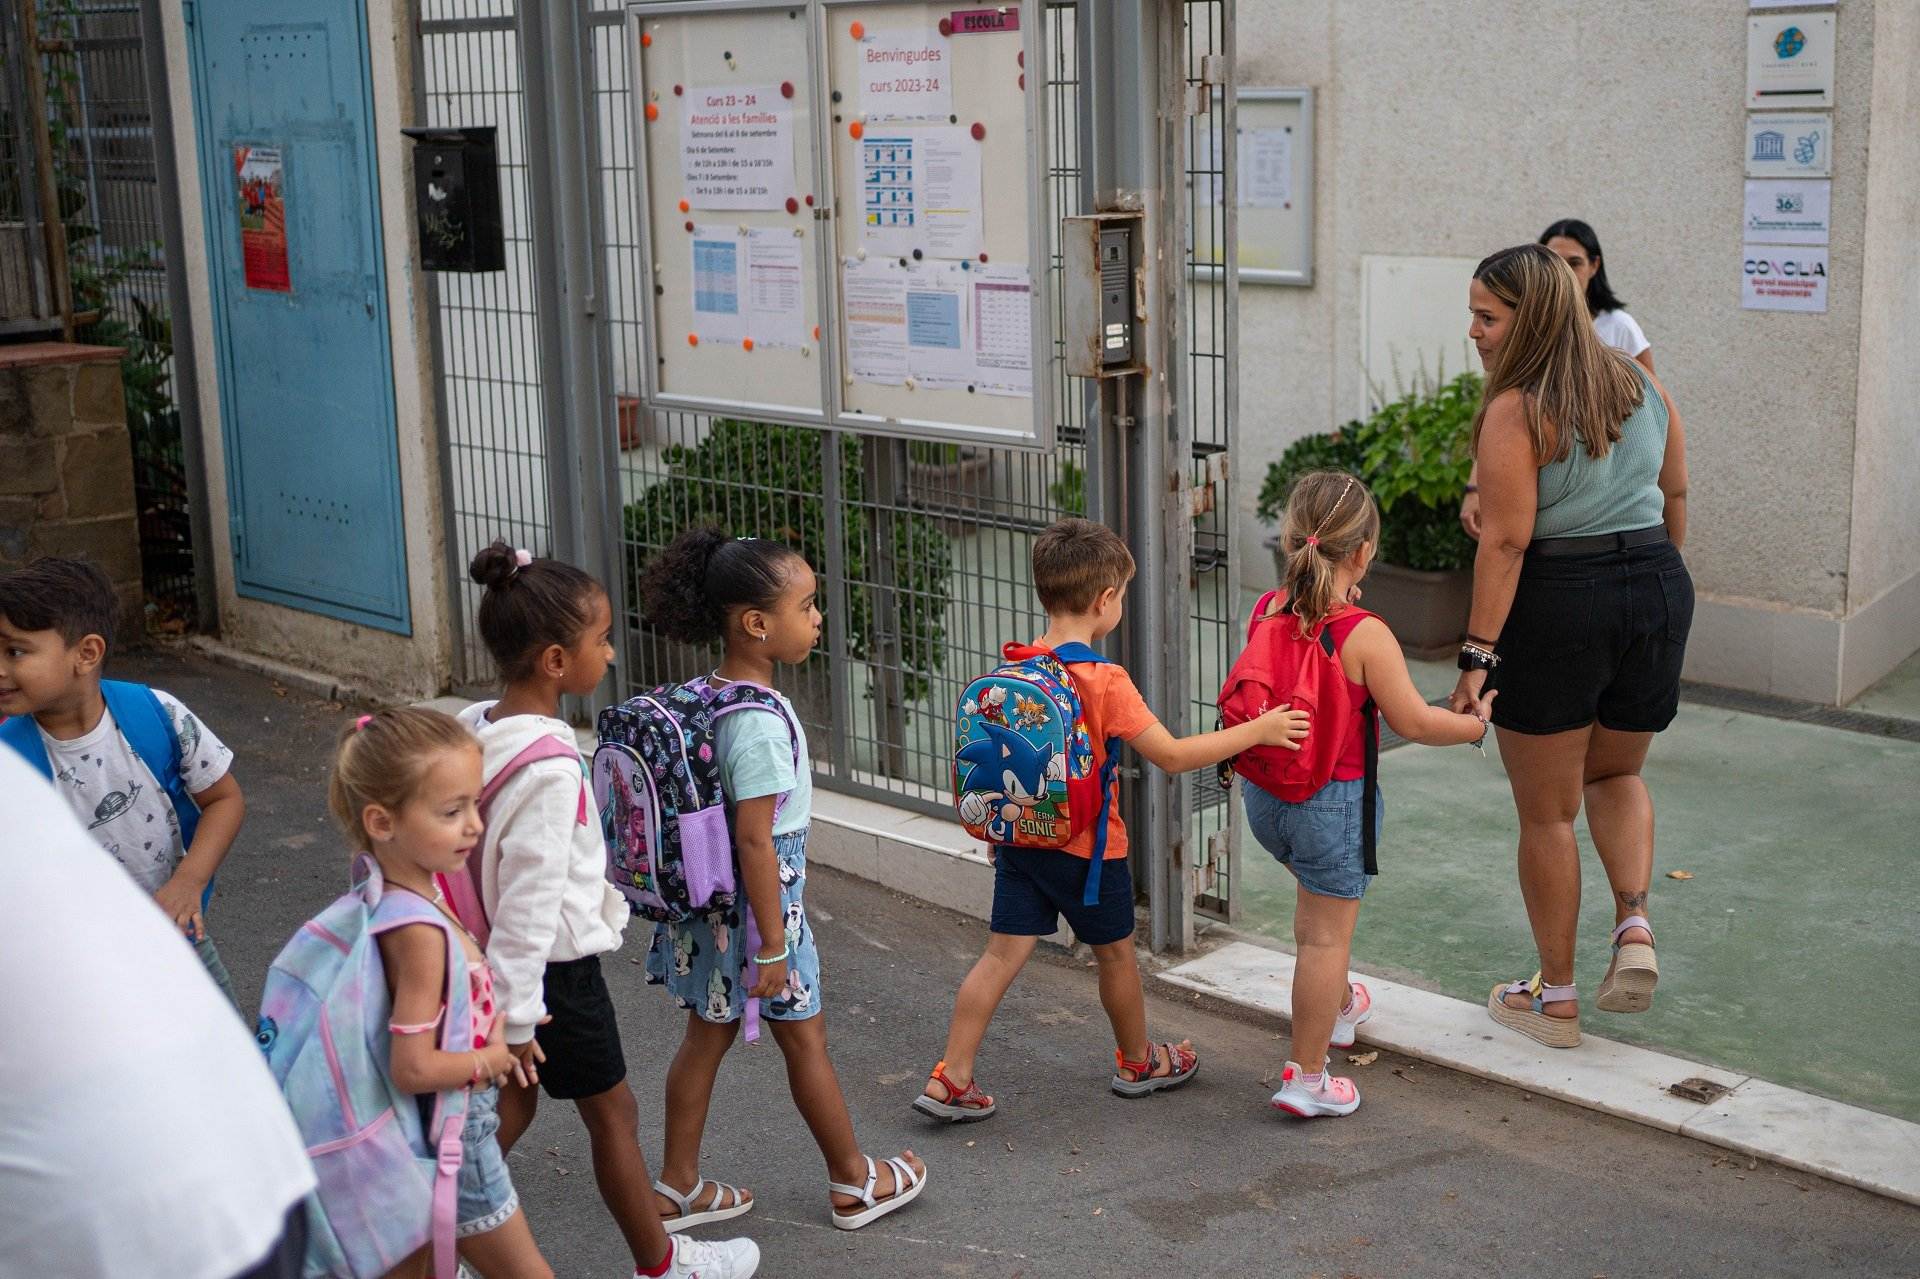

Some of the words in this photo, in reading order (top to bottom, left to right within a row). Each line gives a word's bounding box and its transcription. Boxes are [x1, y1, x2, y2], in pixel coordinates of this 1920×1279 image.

[964, 15, 1005, 29] ESCOLA
[867, 47, 941, 65] Benvingudes
[870, 82, 893, 93] curs
[895, 78, 940, 92] 2023-24
[706, 96, 723, 107] Curs
[726, 95, 736, 106] 23
[745, 95, 756, 106] 24
[728, 113, 740, 124] les
[1033, 810, 1055, 821] TEAM
[1020, 819, 1056, 838] SONIC
